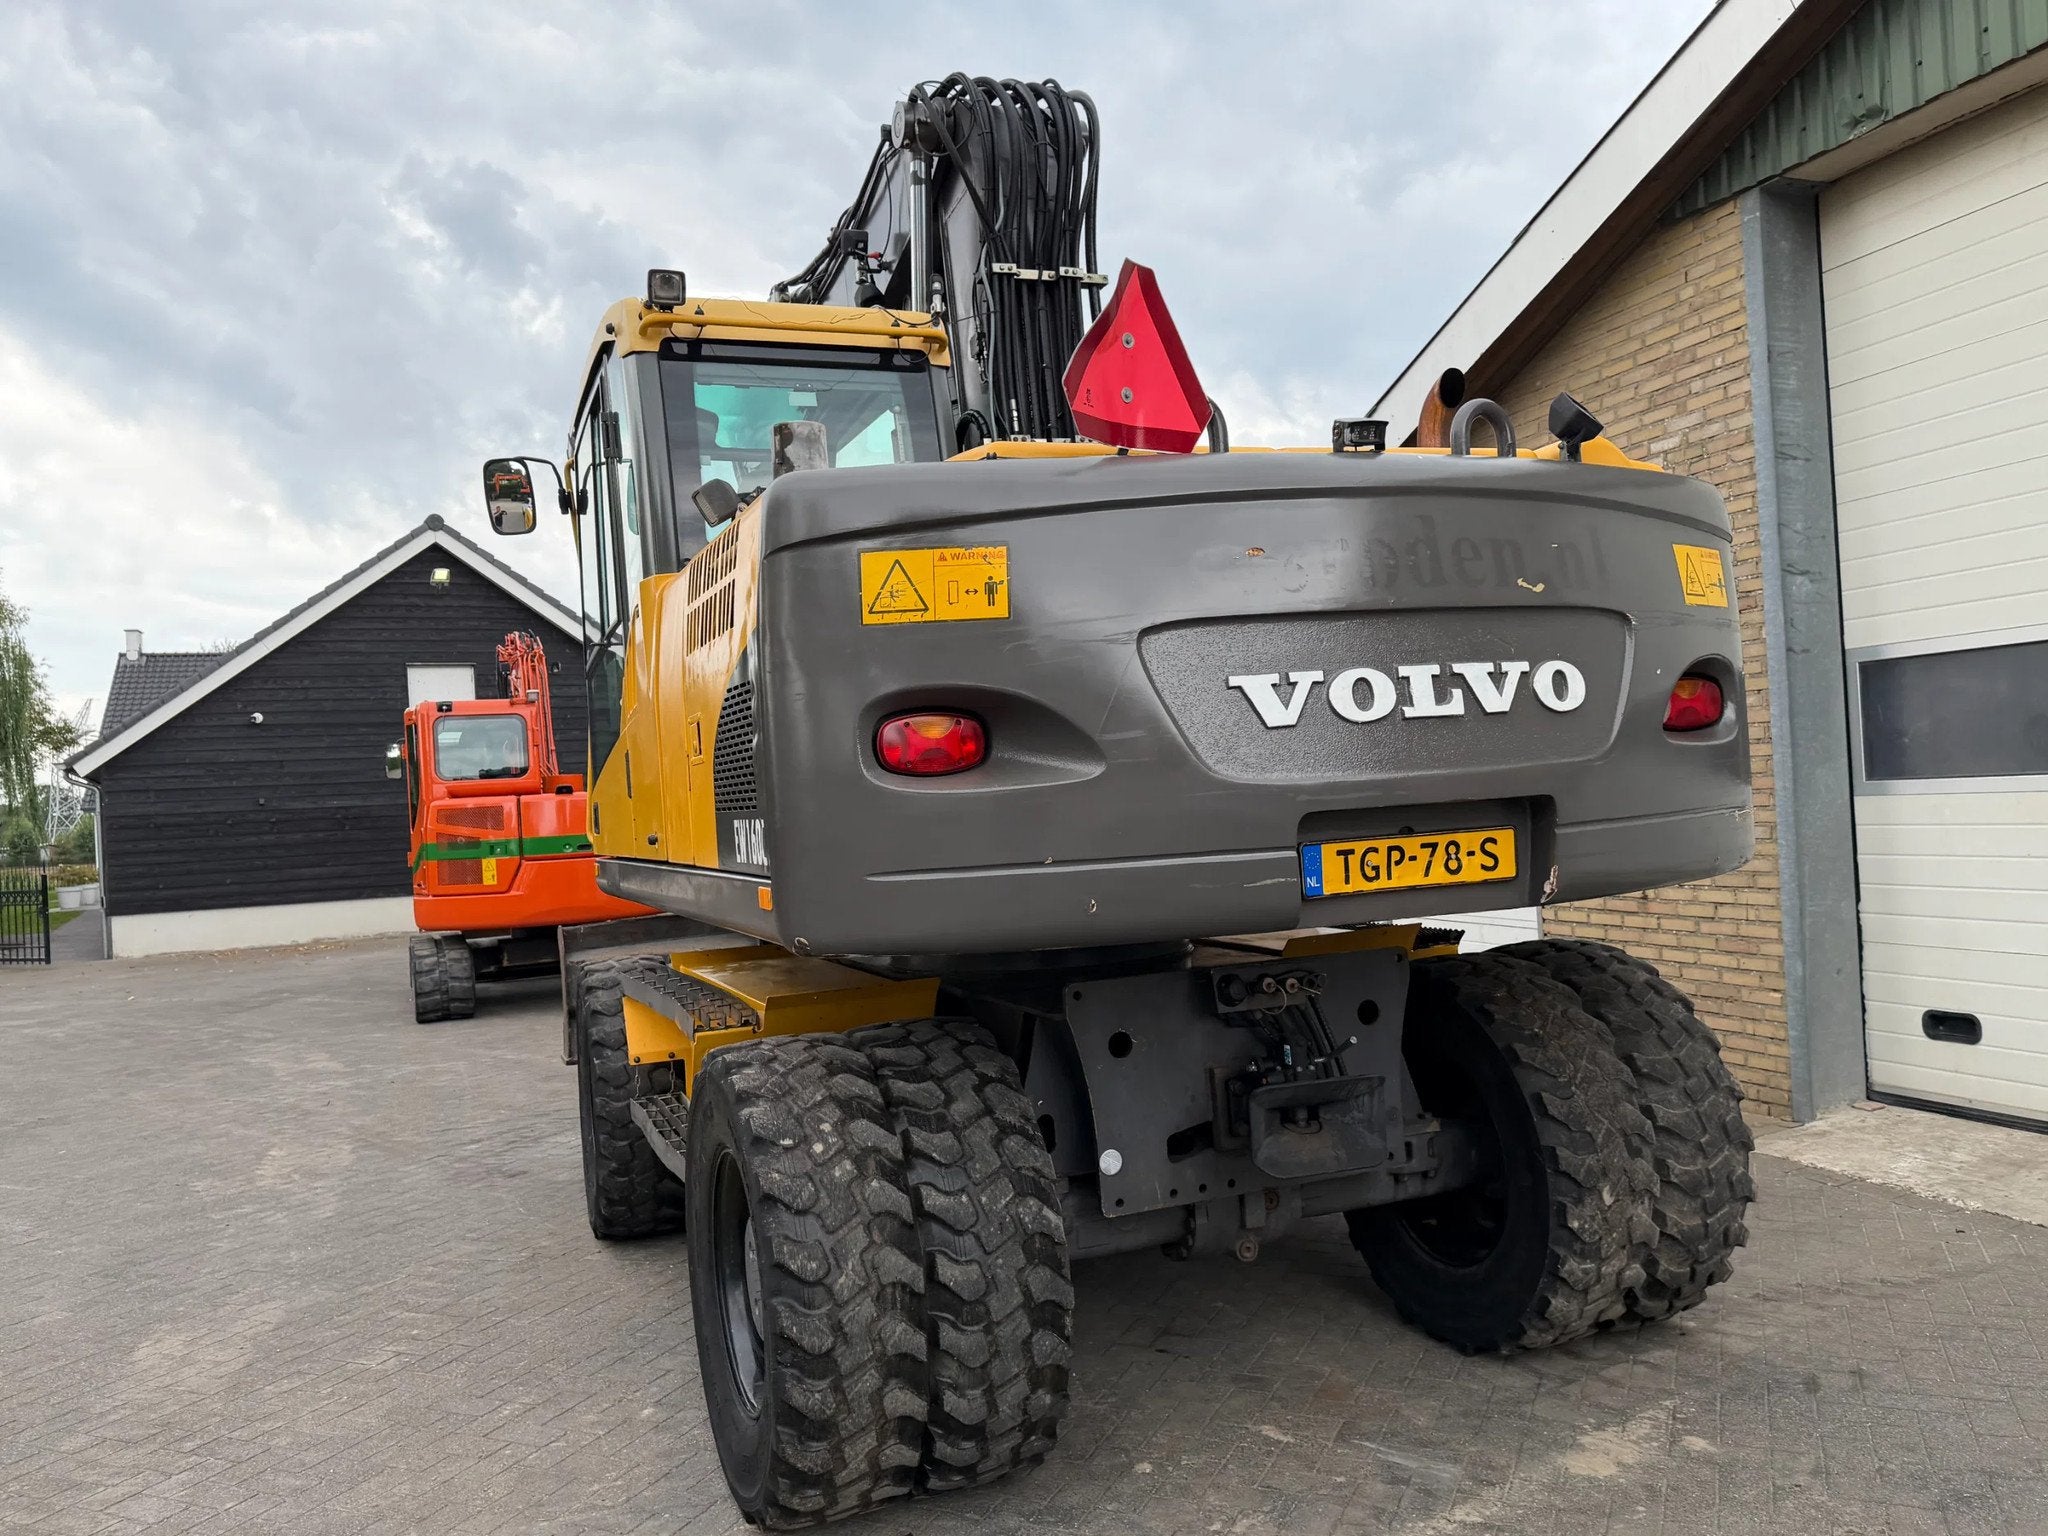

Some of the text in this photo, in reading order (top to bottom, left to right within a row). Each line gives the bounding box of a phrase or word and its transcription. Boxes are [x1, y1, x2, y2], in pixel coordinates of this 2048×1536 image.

[1228, 660, 1586, 728] VOLVO
[1306, 875, 1320, 888] NL
[1336, 836, 1499, 885] TGP-78-S
